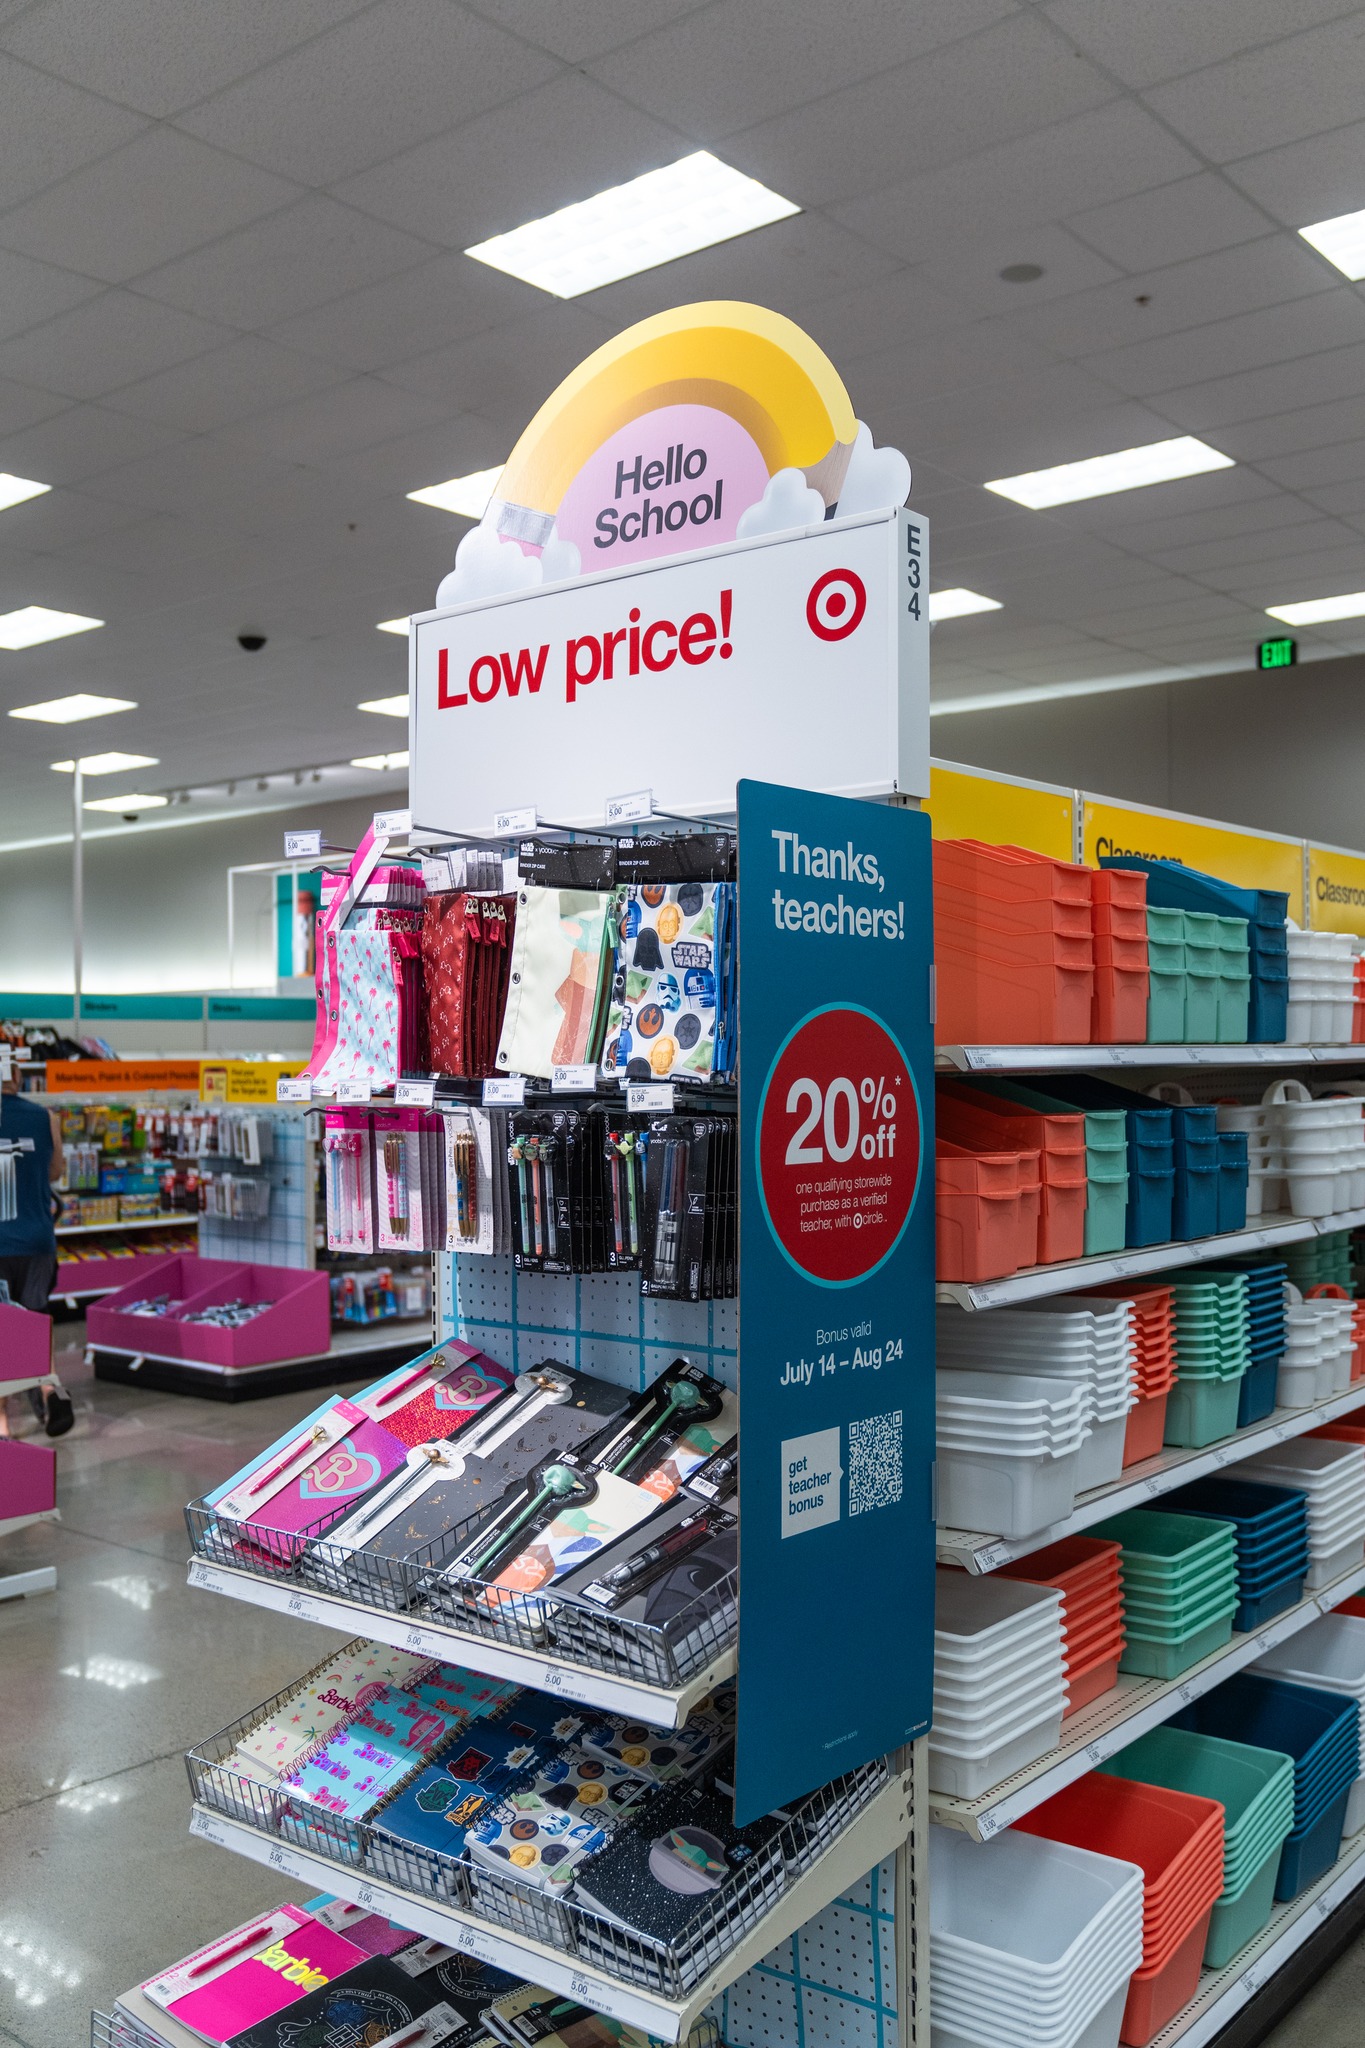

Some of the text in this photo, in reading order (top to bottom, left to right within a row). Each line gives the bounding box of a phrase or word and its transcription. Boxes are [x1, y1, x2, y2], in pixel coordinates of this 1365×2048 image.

[614, 443, 707, 499] Hello
[593, 479, 723, 549] School
[438, 589, 733, 710] Low price!
[1262, 639, 1292, 668] EXIT
[609, 807, 622, 816] 5.00
[376, 821, 386, 829] 5.00
[497, 819, 510, 828] 5.00
[287, 841, 298, 849] 5.00
[771, 829, 885, 893] Thanks,
[771, 889, 905, 940] teachers!
[673, 942, 709, 957] STAR
[674, 954, 710, 968] WARS
[554, 1072, 567, 1080] 5.00
[487, 1086, 499, 1094] 5.00
[631, 1094, 645, 1102] 6.99
[861, 1124, 896, 1160] off
[795, 1173, 892, 1196] one qualifying storewide
[800, 1192, 888, 1216] purchase as a verified
[800, 1217, 833, 1233] teacher,
[834, 1213, 851, 1228] with
[329, 1236, 334, 1244] 3
[449, 1235, 454, 1243] 3
[515, 1254, 521, 1264] 3
[610, 1252, 616, 1262] 3
[642, 1280, 648, 1290] 2
[816, 1320, 872, 1345] Bonus valid
[780, 1359, 814, 1386] July
[818, 1353, 836, 1377] 14
[852, 1346, 882, 1370] Aug
[885, 1339, 904, 1362] 24
[600, 1461, 609, 1469] 2
[788, 1456, 808, 1478] get
[788, 1470, 832, 1495] teacher
[788, 1492, 824, 1515] bonus
[463, 1556, 472, 1565] 2
[982, 1555, 996, 1566] 3.00
[195, 1571, 208, 1582] 5.00
[288, 1599, 302, 1610] 5.00
[406, 1634, 422, 1646] 5.00
[545, 1674, 562, 1686] 5.00
[317, 1688, 357, 1714] Barbie
[196, 1819, 209, 1831] 5.00
[983, 1819, 997, 1832] 3.00
[269, 1852, 283, 1863] 5.00
[357, 1890, 373, 1903] 5.00
[458, 1933, 475, 1947] 5.00
[570, 1981, 588, 1995] 5.00
